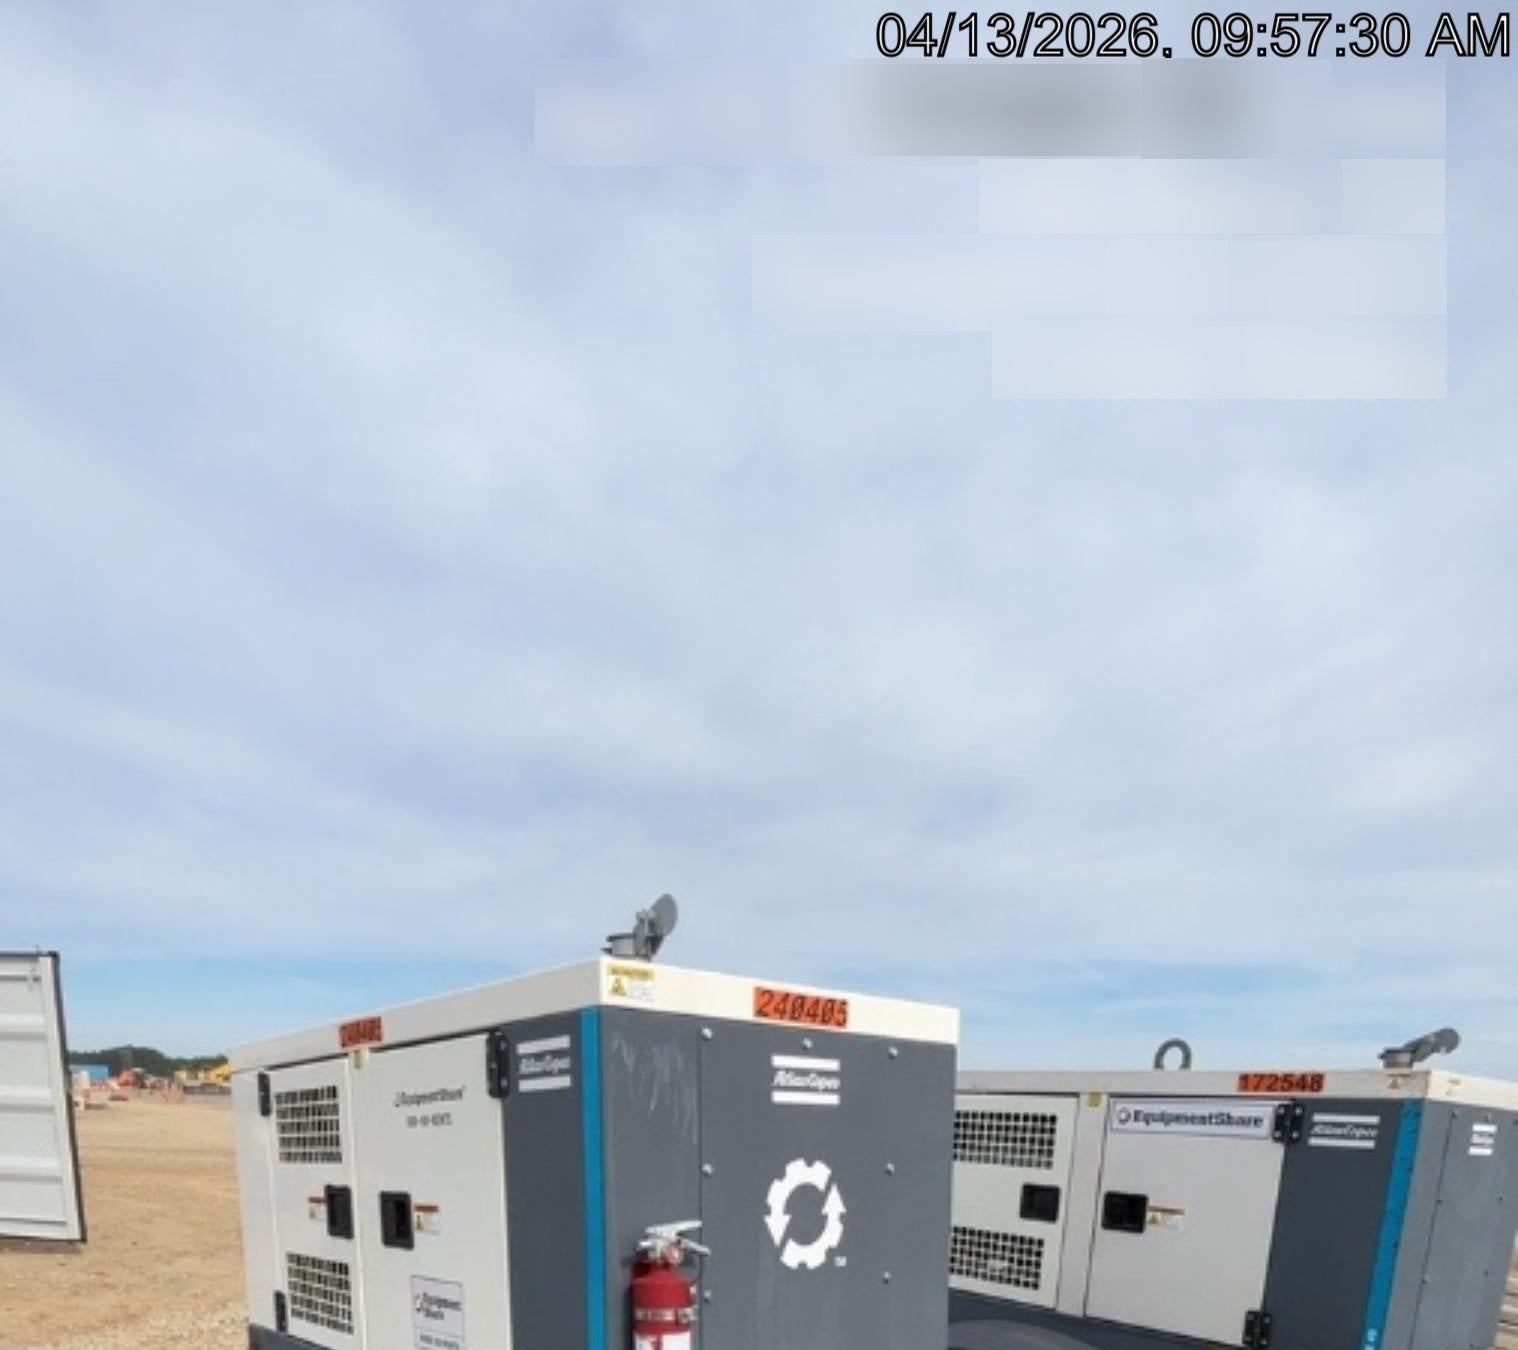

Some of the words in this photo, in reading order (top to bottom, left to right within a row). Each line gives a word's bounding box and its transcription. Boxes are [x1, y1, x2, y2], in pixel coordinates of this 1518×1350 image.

[754, 988, 847, 1027] 240405
[1237, 1073, 1323, 1092] 172548
[1132, 1109, 1263, 1128] EquipmentShare
